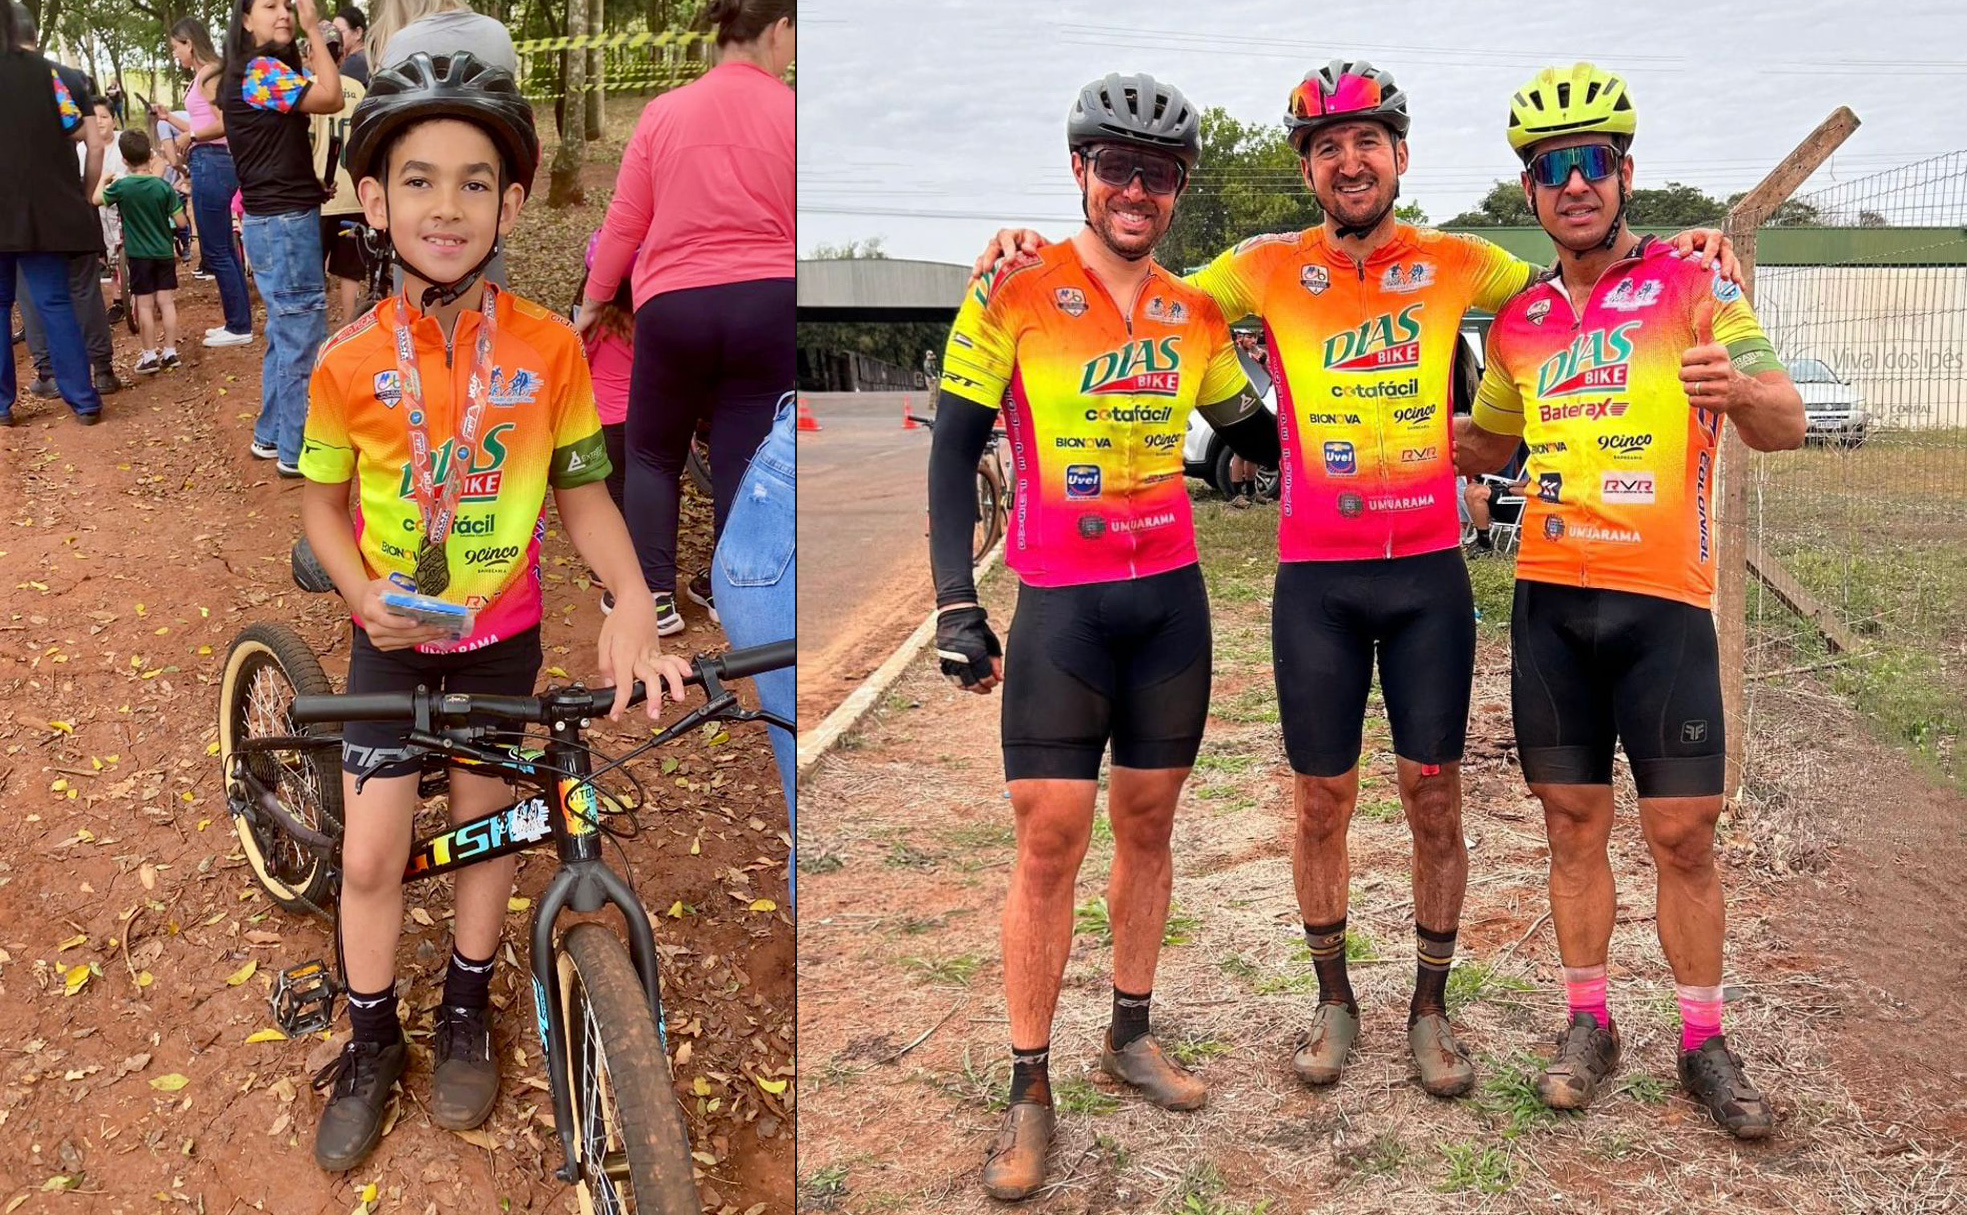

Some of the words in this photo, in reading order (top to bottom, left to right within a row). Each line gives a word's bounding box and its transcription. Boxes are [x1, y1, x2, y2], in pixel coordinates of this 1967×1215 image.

[1324, 303, 1423, 369] DIAS
[1378, 344, 1418, 363] BIKE
[1537, 320, 1643, 398] DIAS
[1885, 346, 1919, 369] dos
[1925, 347, 1964, 373] Ipês
[1080, 336, 1181, 393] DIAS
[942, 371, 984, 387] RT
[1137, 374, 1177, 389] BIKE
[1584, 366, 1626, 384] BIKE
[1332, 378, 1418, 397] cotafácil
[1085, 405, 1172, 421] cotafácil
[1309, 413, 1361, 424] BIONOVA
[1056, 437, 1111, 448] BIONOVA
[1326, 452, 1352, 462] Uvel
[1402, 447, 1437, 460] RVR
[463, 473, 500, 493] IKE
[1068, 475, 1098, 485] Uvel
[1604, 480, 1652, 491] RVR
[1369, 494, 1435, 510] UMUARAMA
[402, 514, 495, 534] cofácil
[1111, 513, 1176, 531] UMUARAMA
[381, 541, 419, 562] BIONO
